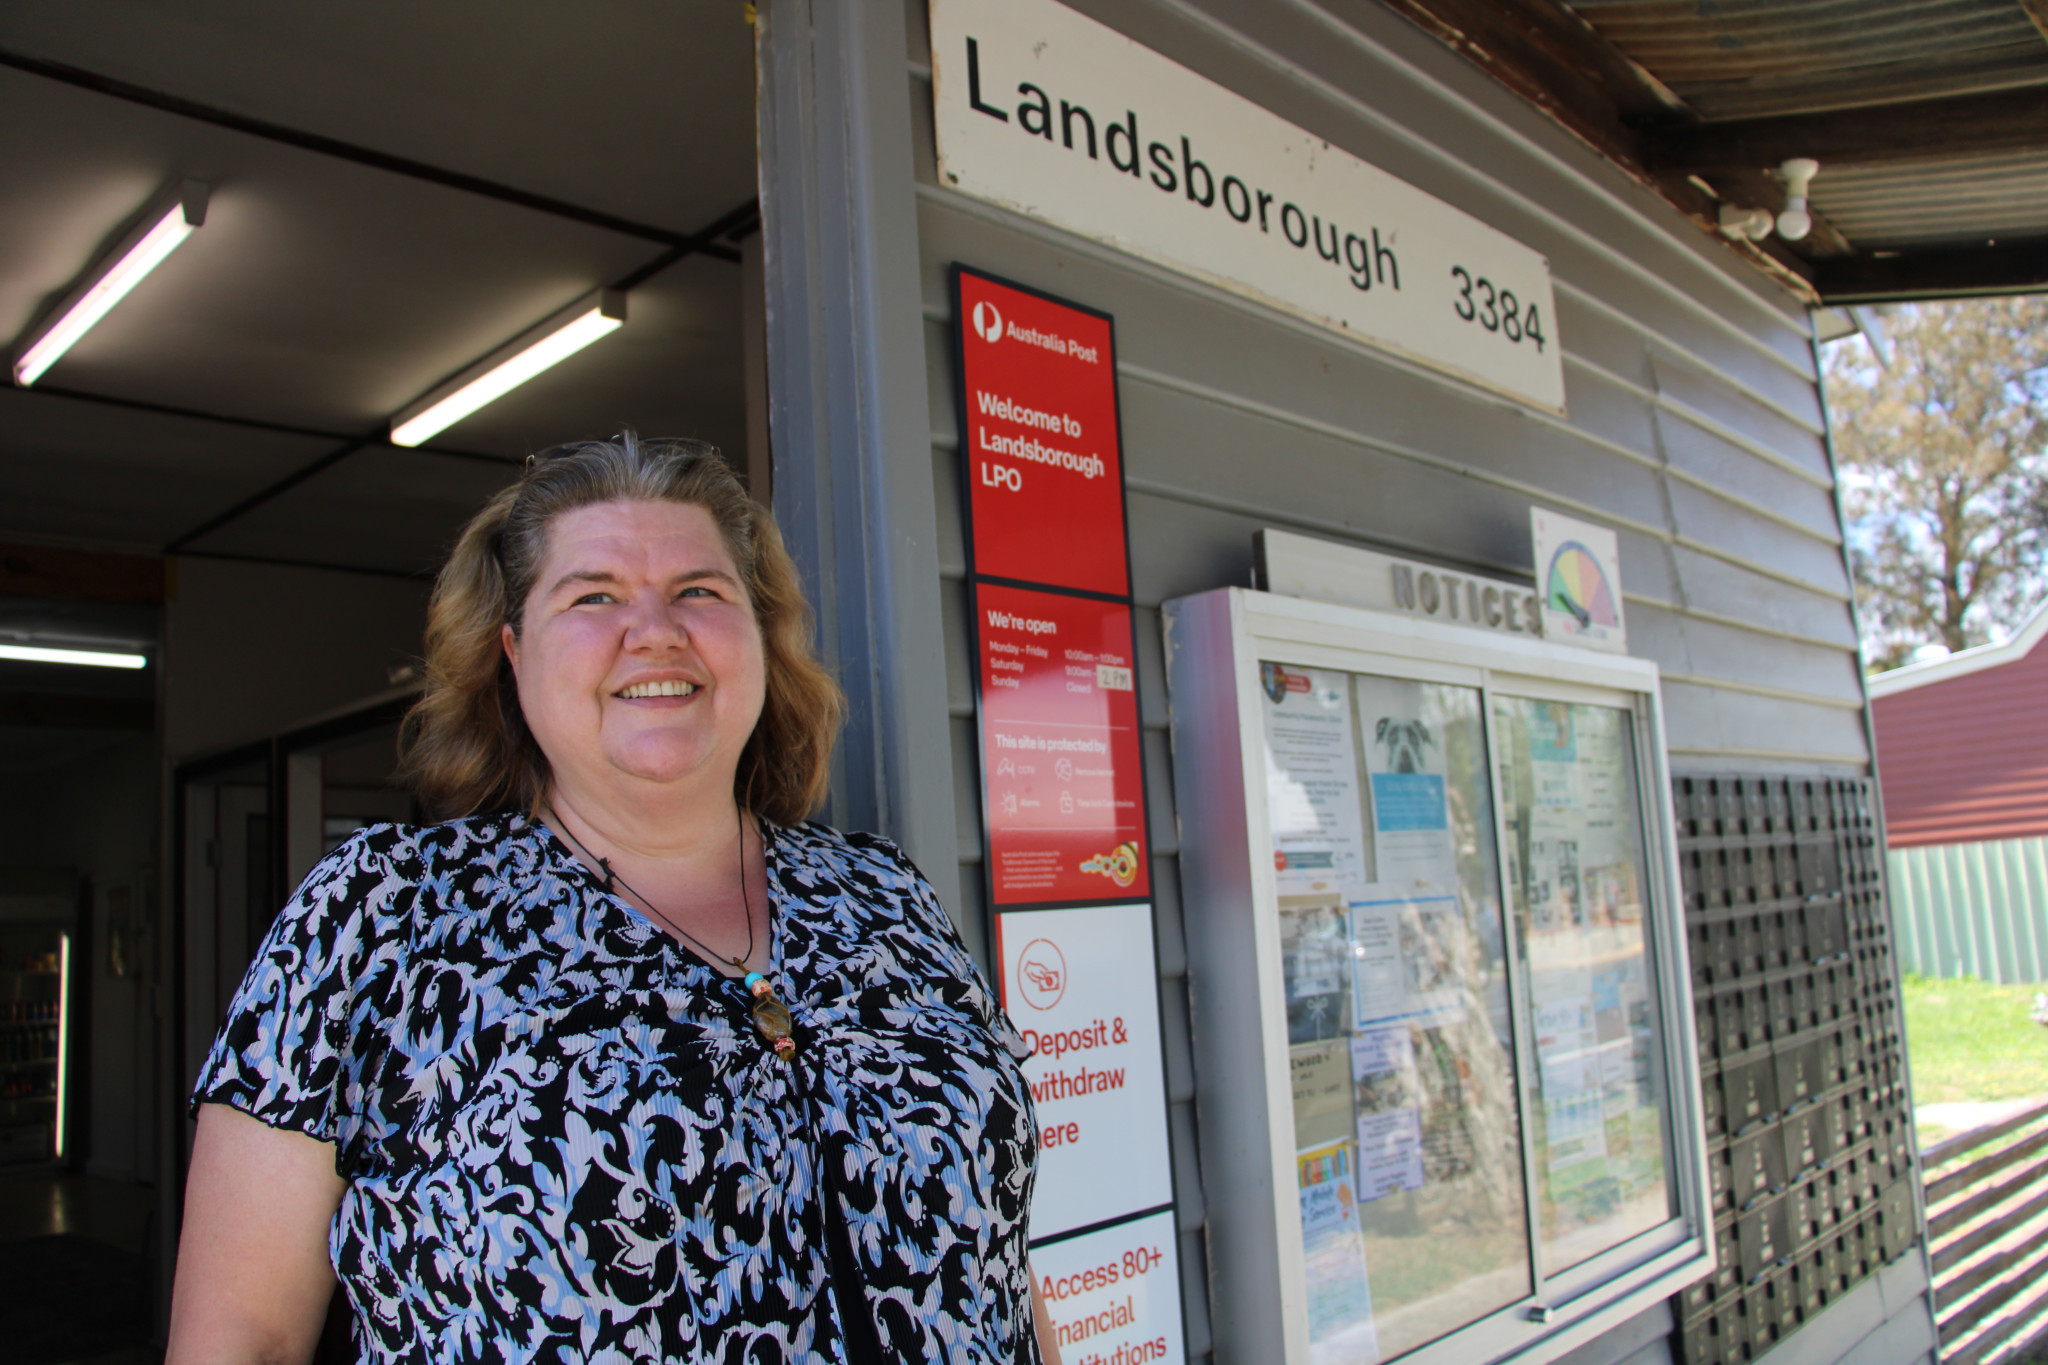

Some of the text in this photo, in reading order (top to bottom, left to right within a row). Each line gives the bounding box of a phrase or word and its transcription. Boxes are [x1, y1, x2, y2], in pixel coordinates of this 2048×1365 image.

[966, 36, 1545, 353] Landsborough 3384
[1006, 321, 1098, 364] Australia Post
[977, 390, 1081, 438] Welcome to
[980, 426, 1105, 479] Landsborough
[982, 462, 1022, 492] LPO
[1390, 562, 1542, 636] NOTICES
[987, 610, 1057, 636] We’re open
[989, 641, 1019, 656] Monday
[1026, 645, 1048, 660] Friday
[990, 658, 1024, 673] Saturday
[991, 675, 1020, 689] Sunday
[1066, 681, 1091, 694] Closed
[1102, 670, 1112, 685] 2
[995, 734, 1106, 754] This site is protected by
[1023, 1017, 1127, 1059] Deposit &
[1042, 1246, 1162, 1302] Access 80+
[1051, 1295, 1135, 1346] inancial
